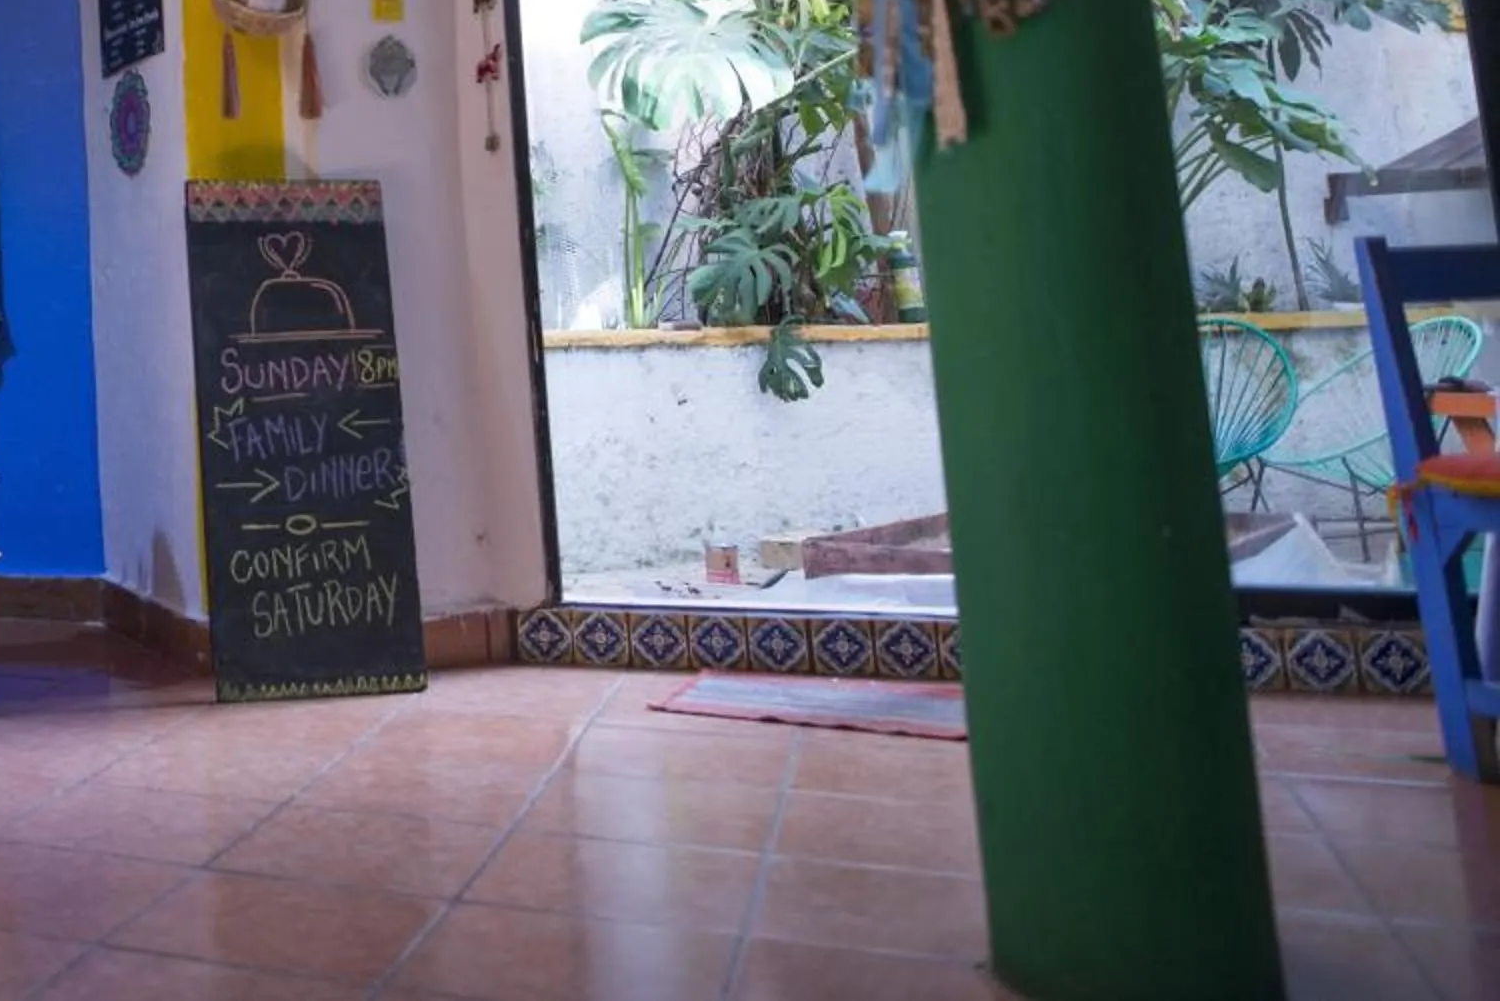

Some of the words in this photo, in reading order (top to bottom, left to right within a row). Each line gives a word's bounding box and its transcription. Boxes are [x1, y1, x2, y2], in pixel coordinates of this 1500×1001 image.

[220, 347, 350, 394] SUNDAY
[227, 411, 328, 463] FAMILY
[230, 534, 373, 584] CONFIRM
[252, 571, 398, 639] SATURDAY
